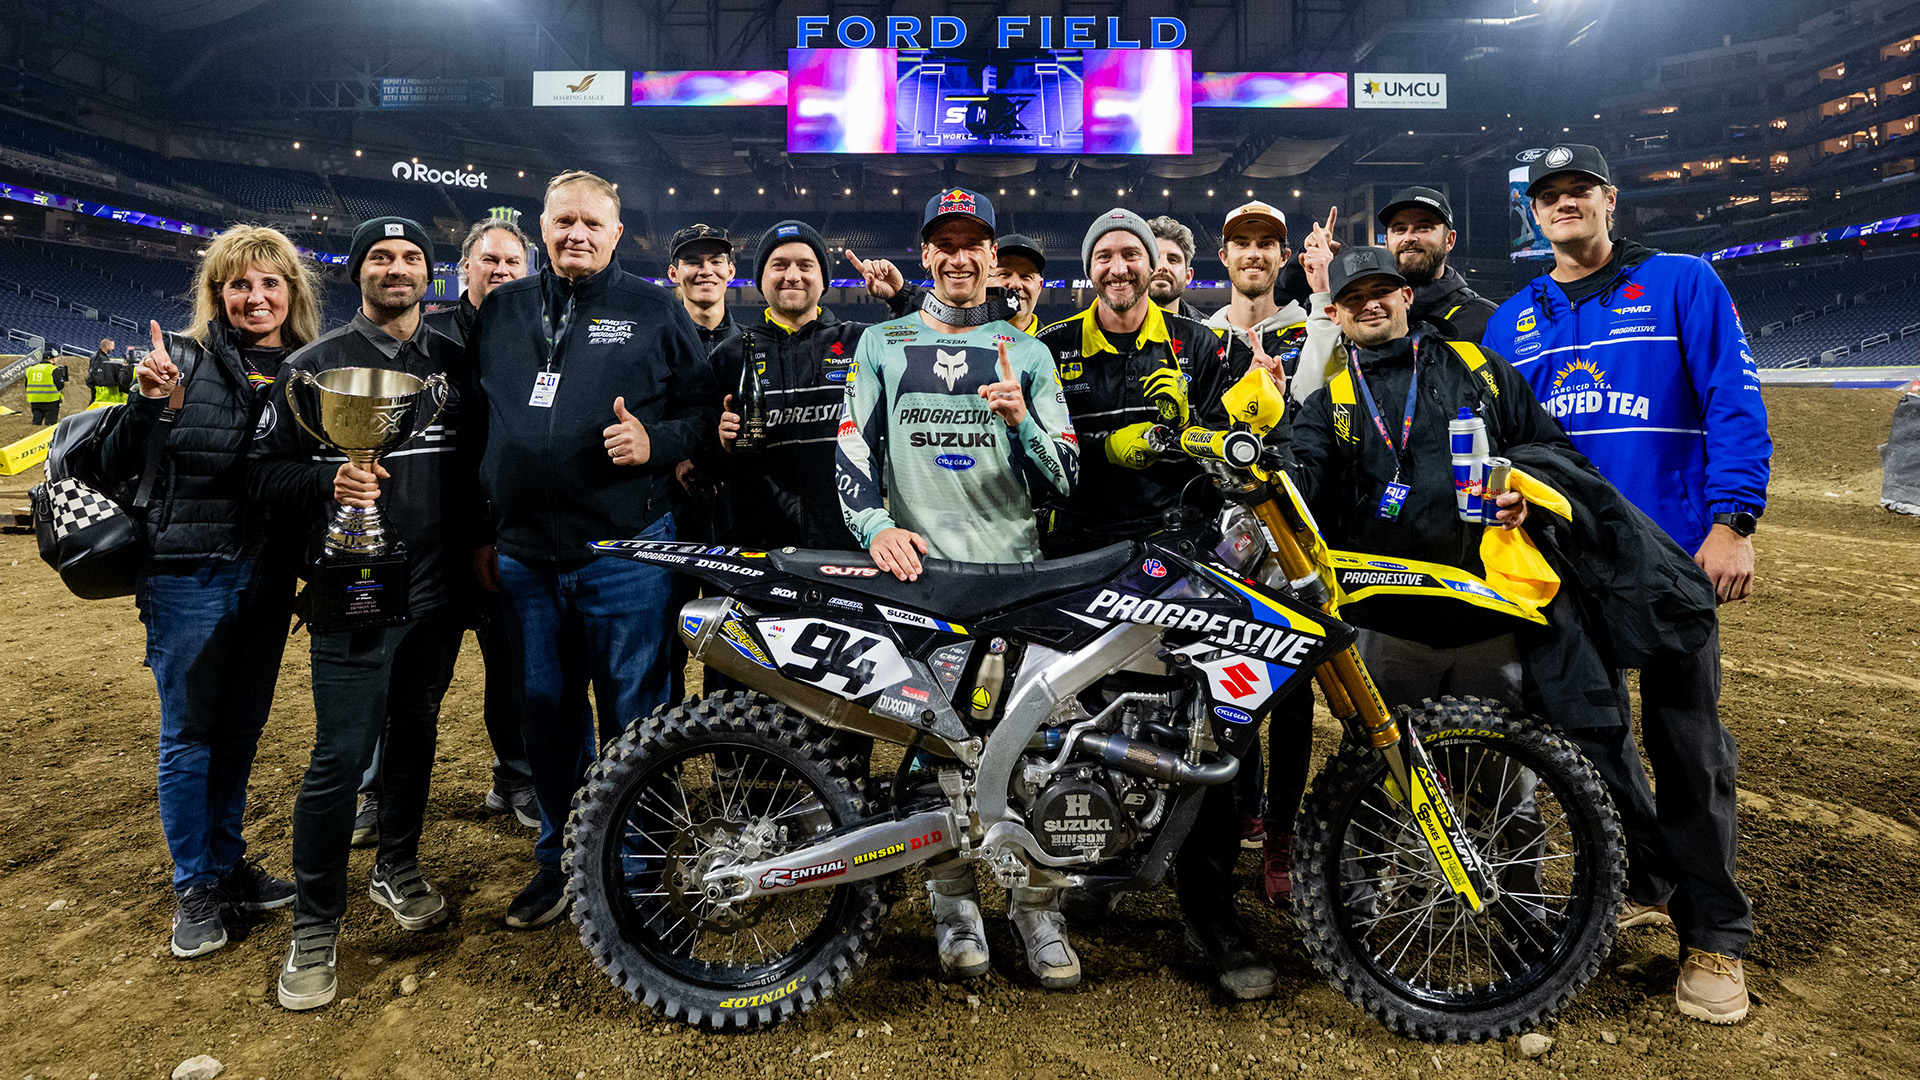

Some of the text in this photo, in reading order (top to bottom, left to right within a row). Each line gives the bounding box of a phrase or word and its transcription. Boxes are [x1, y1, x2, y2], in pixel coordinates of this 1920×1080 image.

[795, 15, 1188, 50] FORD FIELD
[1384, 82, 1440, 97] UMCU
[414, 163, 488, 189] Rocket
[938, 203, 976, 215] Red Bull
[928, 301, 943, 316] FOX
[1621, 305, 1652, 315] PMG
[588, 324, 632, 332] SUZUKI
[588, 331, 635, 339] PROGRESSIVE
[1037, 322, 1068, 338] SUZUKI
[1608, 325, 1657, 336] PROGRESSIVE
[0, 356, 35, 380] MONSTER
[32, 372, 43, 382] 19
[547, 377, 556, 387] L1
[1480, 369, 1500, 398] albek
[1594, 382, 1612, 390] TEA
[1606, 391, 1650, 421] TEA
[900, 408, 997, 425] PROGRESSIVE
[910, 432, 997, 448] SUZUKI
[937, 457, 972, 466] CYCLE GEAR
[1455, 479, 1468, 487] Red
[1394, 488, 1407, 500] L2
[633, 550, 689, 564] PROGRESSIVE
[1335, 557, 1358, 565] WD-40
[695, 559, 765, 577] DUNLOP
[819, 565, 880, 577] GUTS
[1342, 571, 1424, 586] PROGRESSIVE
[770, 587, 798, 599] SKDA
[886, 609, 926, 624] SUZUKI
[1085, 589, 1316, 666] PROGRESSIVE
[724, 621, 770, 664] CIRCUIT
[781, 622, 882, 695] 94
[901, 687, 929, 701] makita
[878, 695, 916, 717] DIXXON
[1217, 708, 1250, 723] CYCLE GEAR
[1423, 728, 1506, 744] DUNLOP
[1417, 766, 1452, 828] ACERBIS
[1044, 819, 1109, 832] SUZUKI
[909, 830, 942, 851] DID
[1051, 834, 1106, 843] HINSON
[853, 842, 905, 865] HINSON
[760, 859, 847, 889] RENTHAL
[719, 978, 798, 1009] DUNLOP
